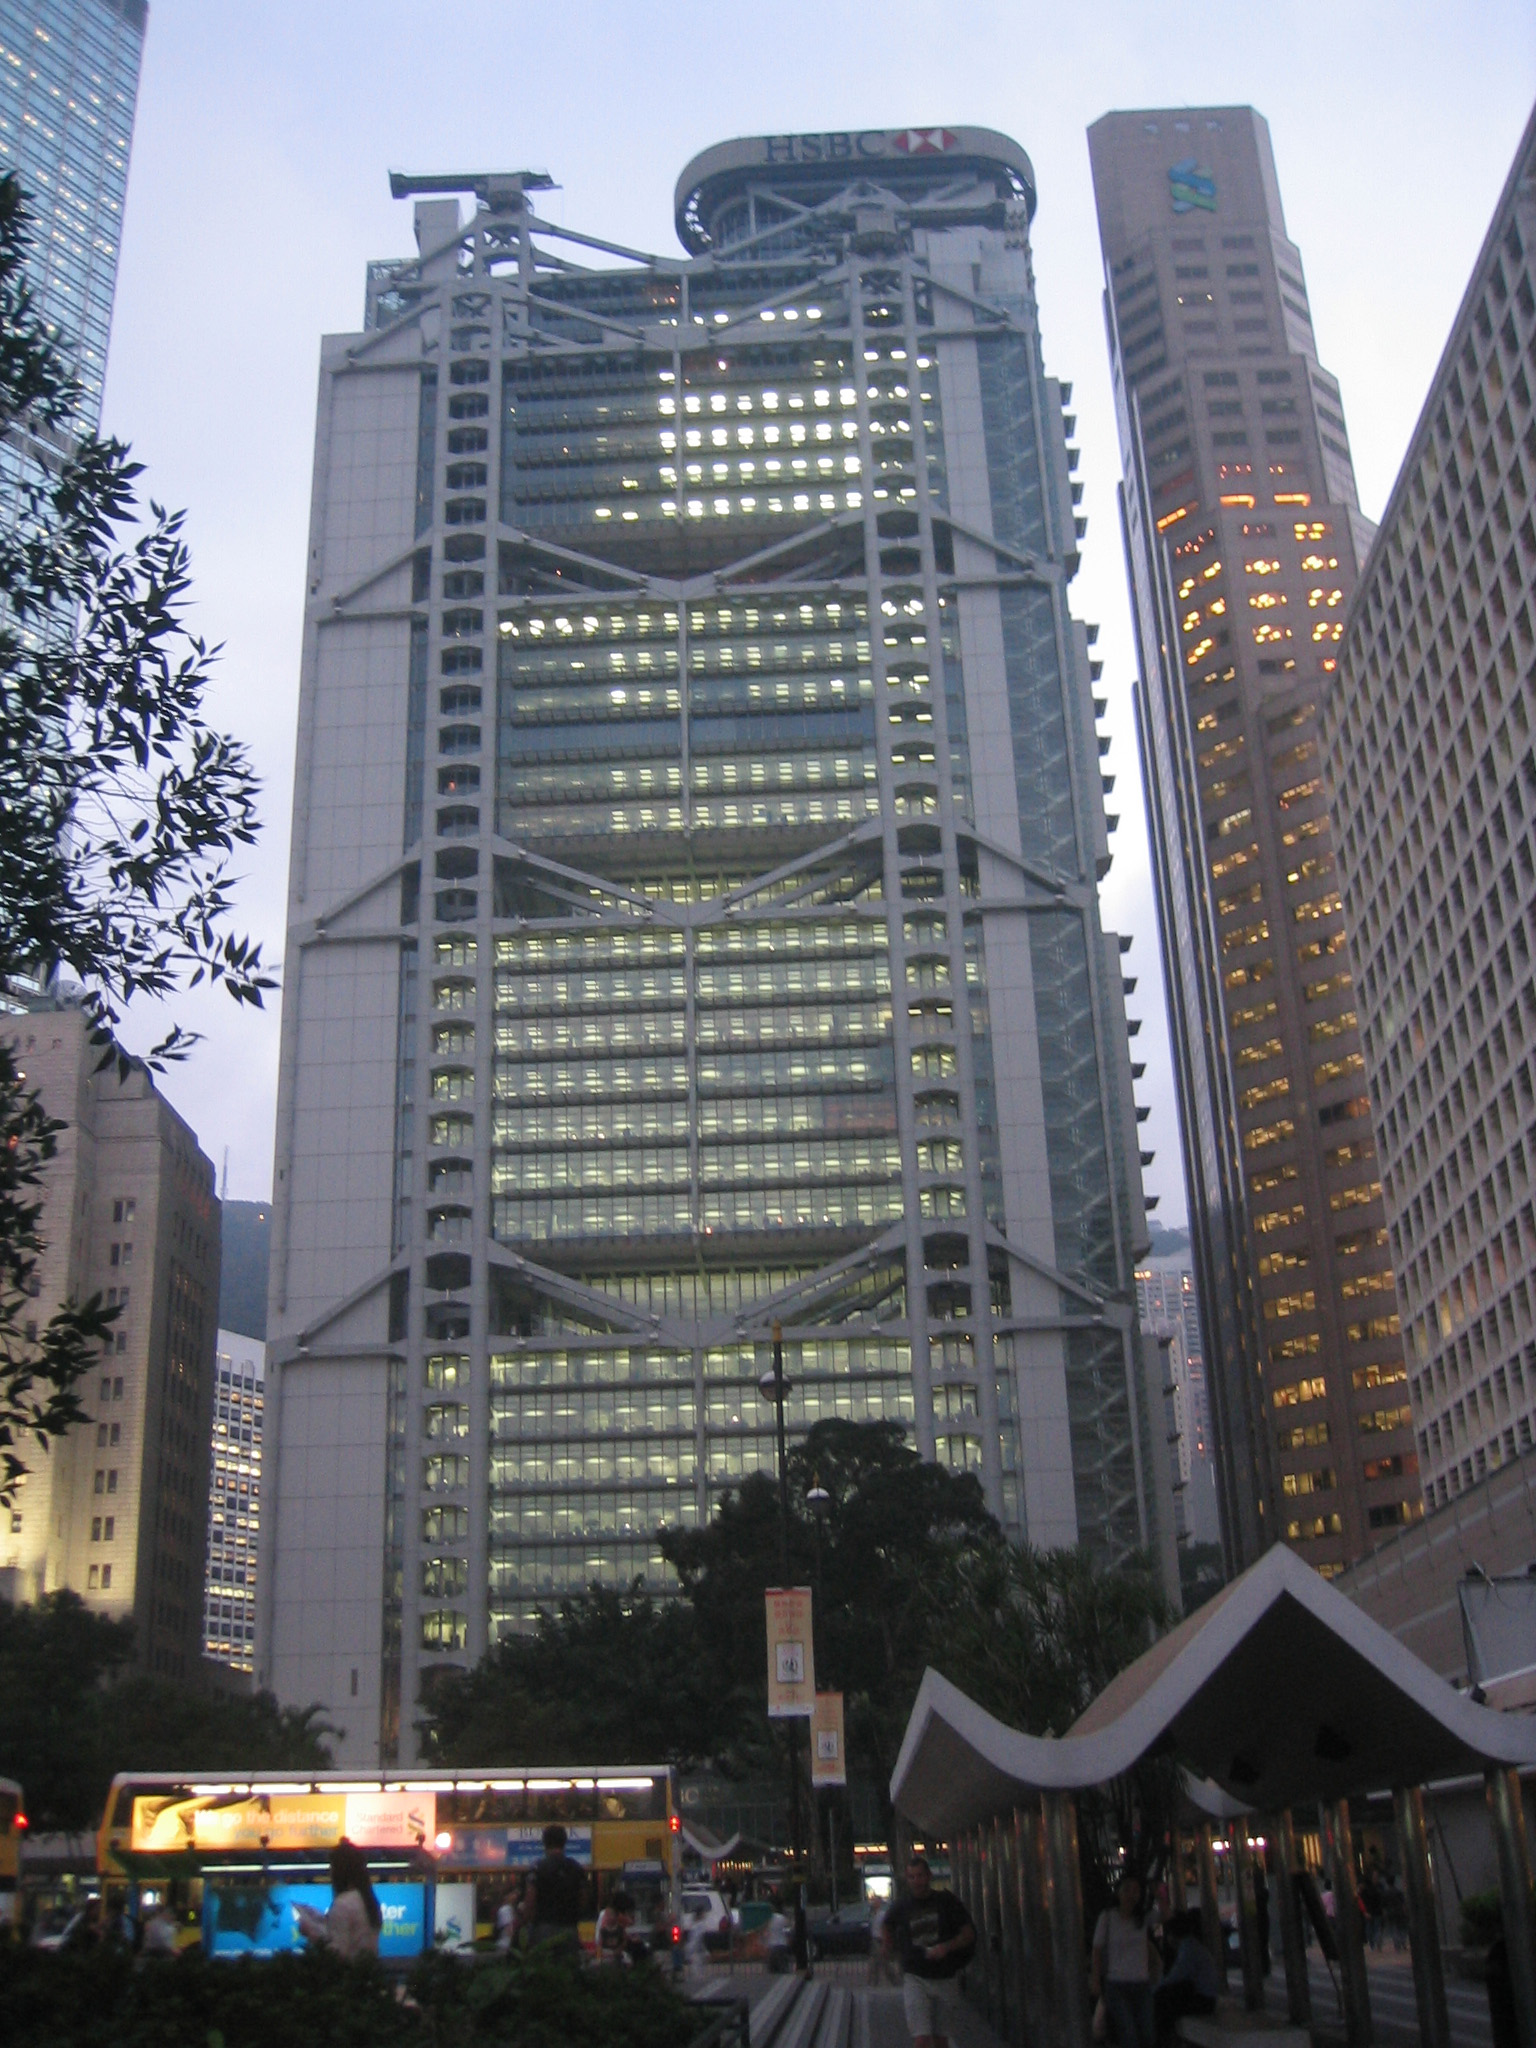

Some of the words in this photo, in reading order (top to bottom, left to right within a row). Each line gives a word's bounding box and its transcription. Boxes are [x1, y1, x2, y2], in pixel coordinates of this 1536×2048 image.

[765, 131, 886, 162] HSBC
[223, 1811, 242, 1827] go
[246, 1809, 270, 1824] the
[273, 1809, 339, 1825] distance
[356, 1811, 404, 1823] Standard
[352, 1824, 404, 1835] Chartered
